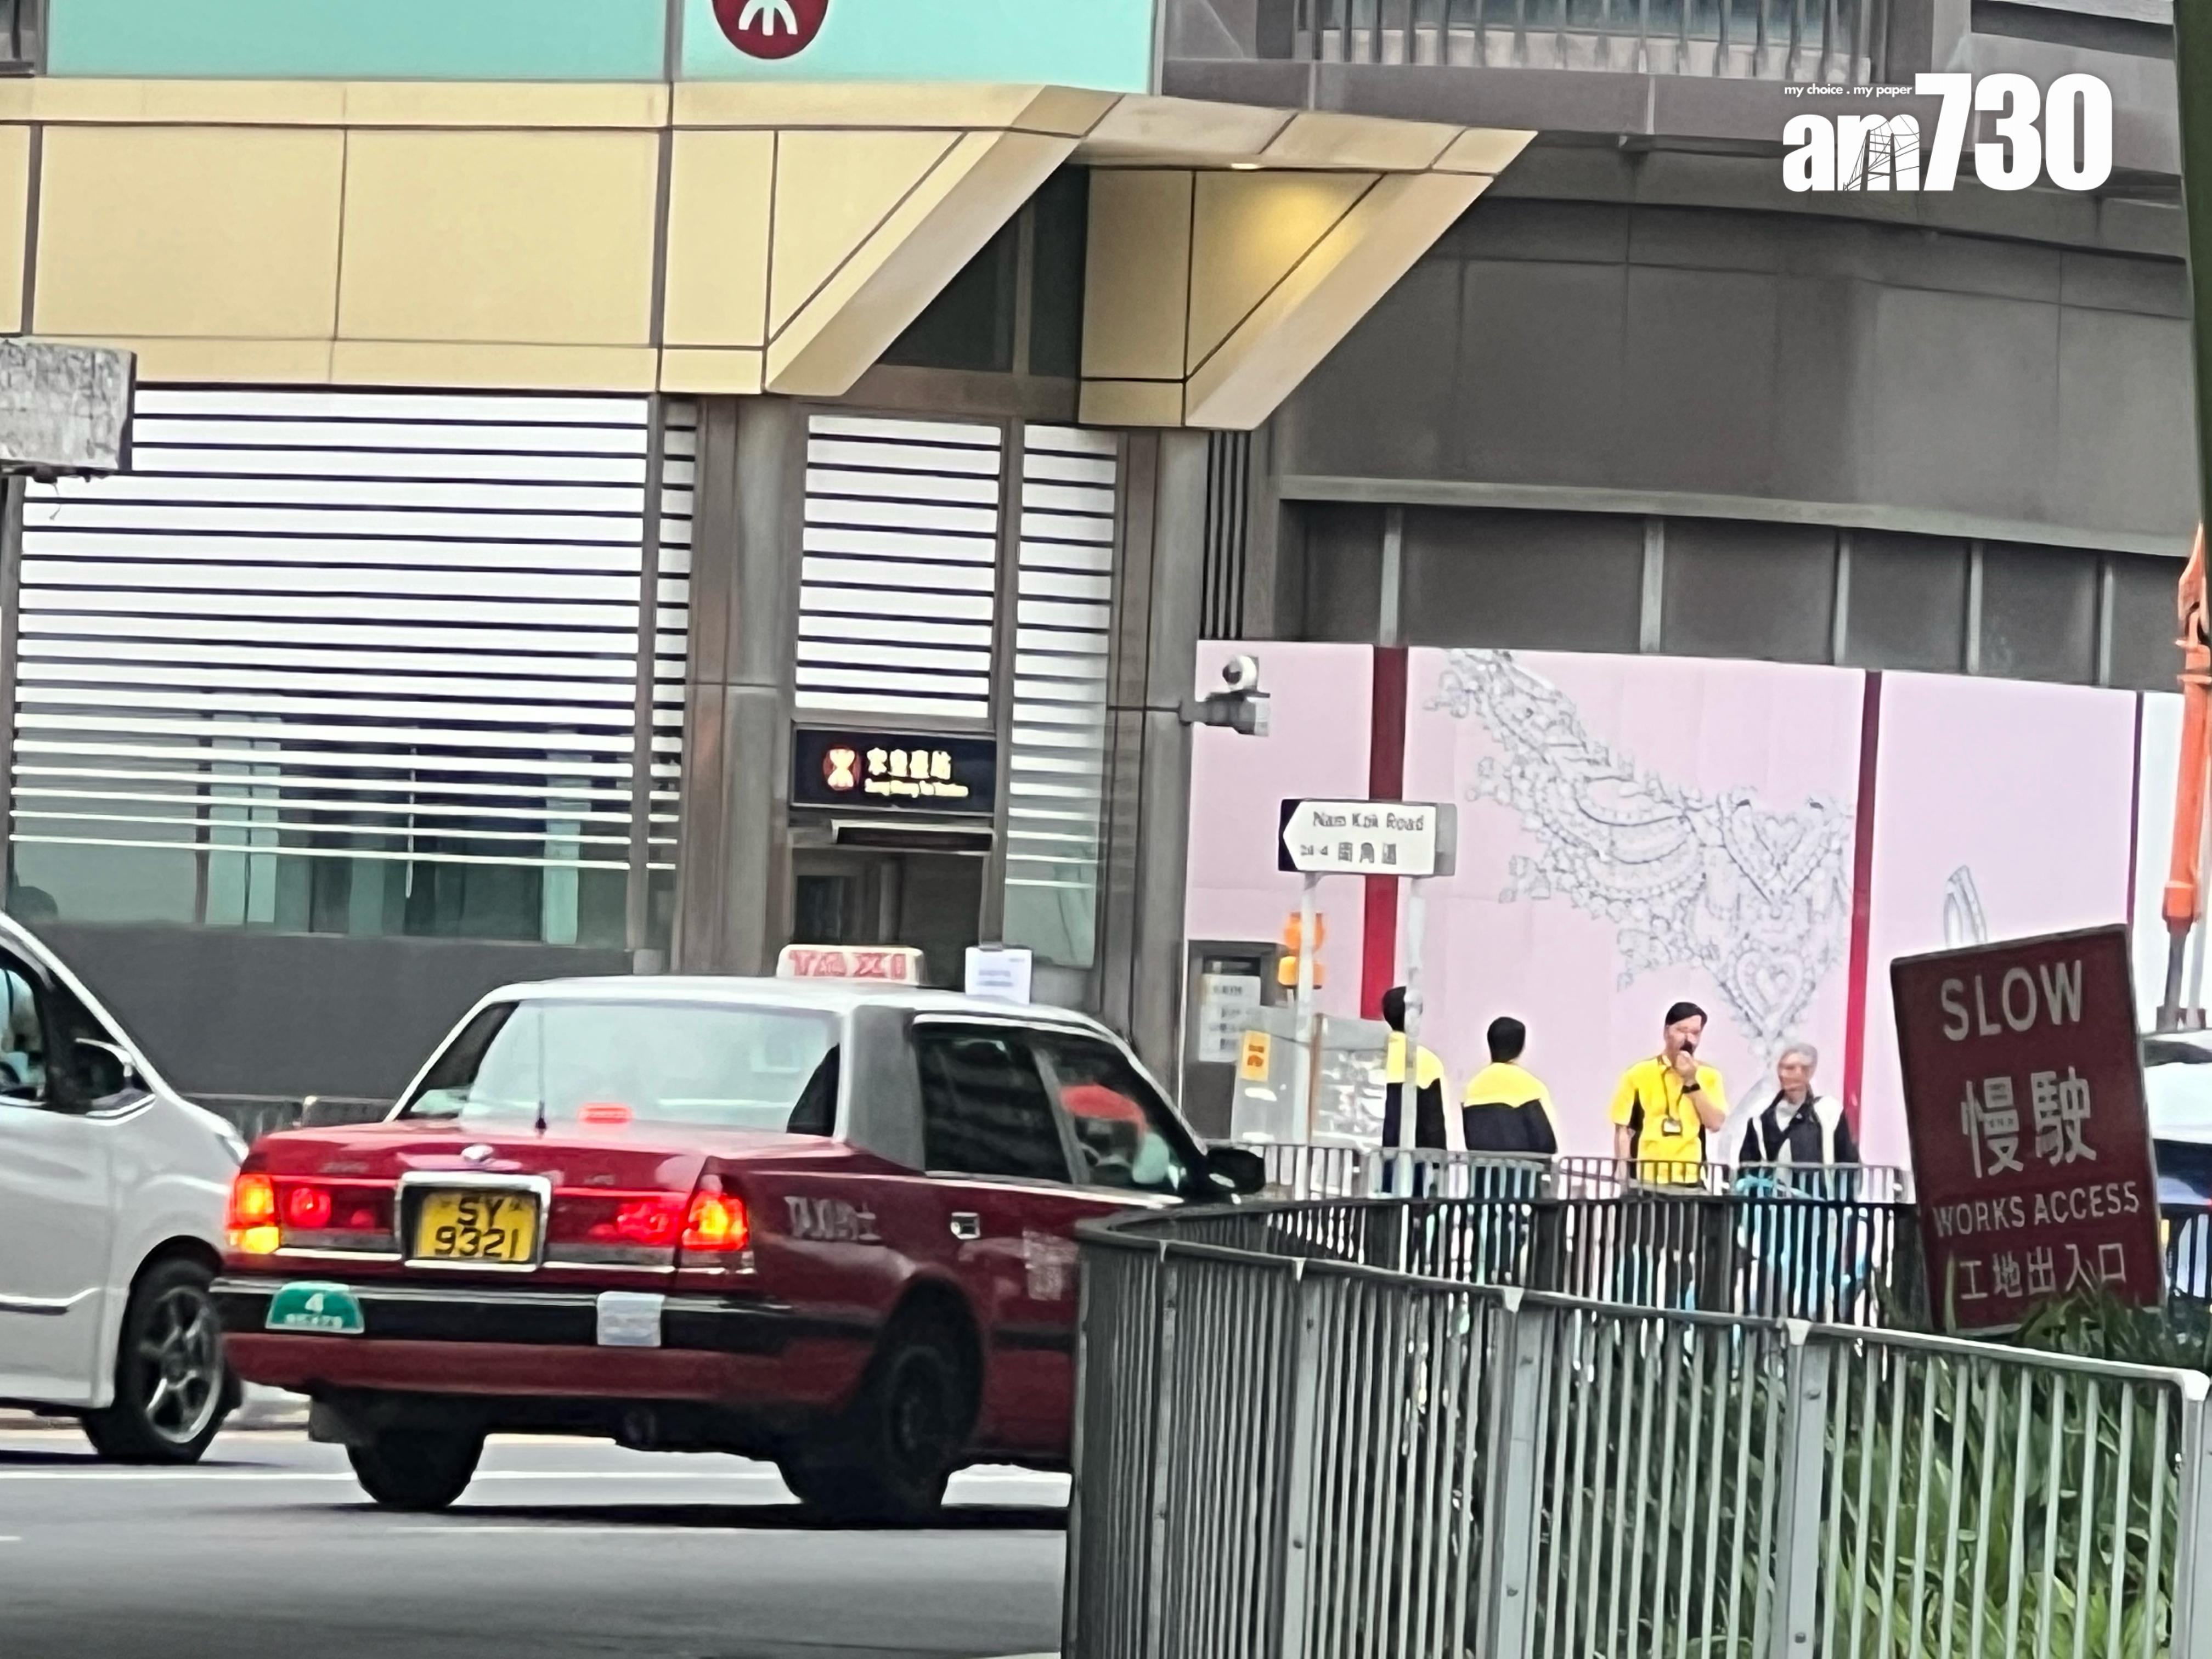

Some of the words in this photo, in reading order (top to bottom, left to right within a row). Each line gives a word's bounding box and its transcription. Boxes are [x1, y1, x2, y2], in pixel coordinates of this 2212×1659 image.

[1386, 812, 1424, 831] Road
[788, 950, 906, 979] TAXI
[1940, 960, 2082, 1041] SLOW
[1961, 1066, 2096, 1178] 慢駛
[457, 1197, 504, 1227] SY
[1932, 1196, 2025, 1238] WORKS
[2034, 1181, 2140, 1226] ACCESS
[435, 1226, 519, 1259] 9321
[1960, 1243, 2126, 1300] 工地出入口
